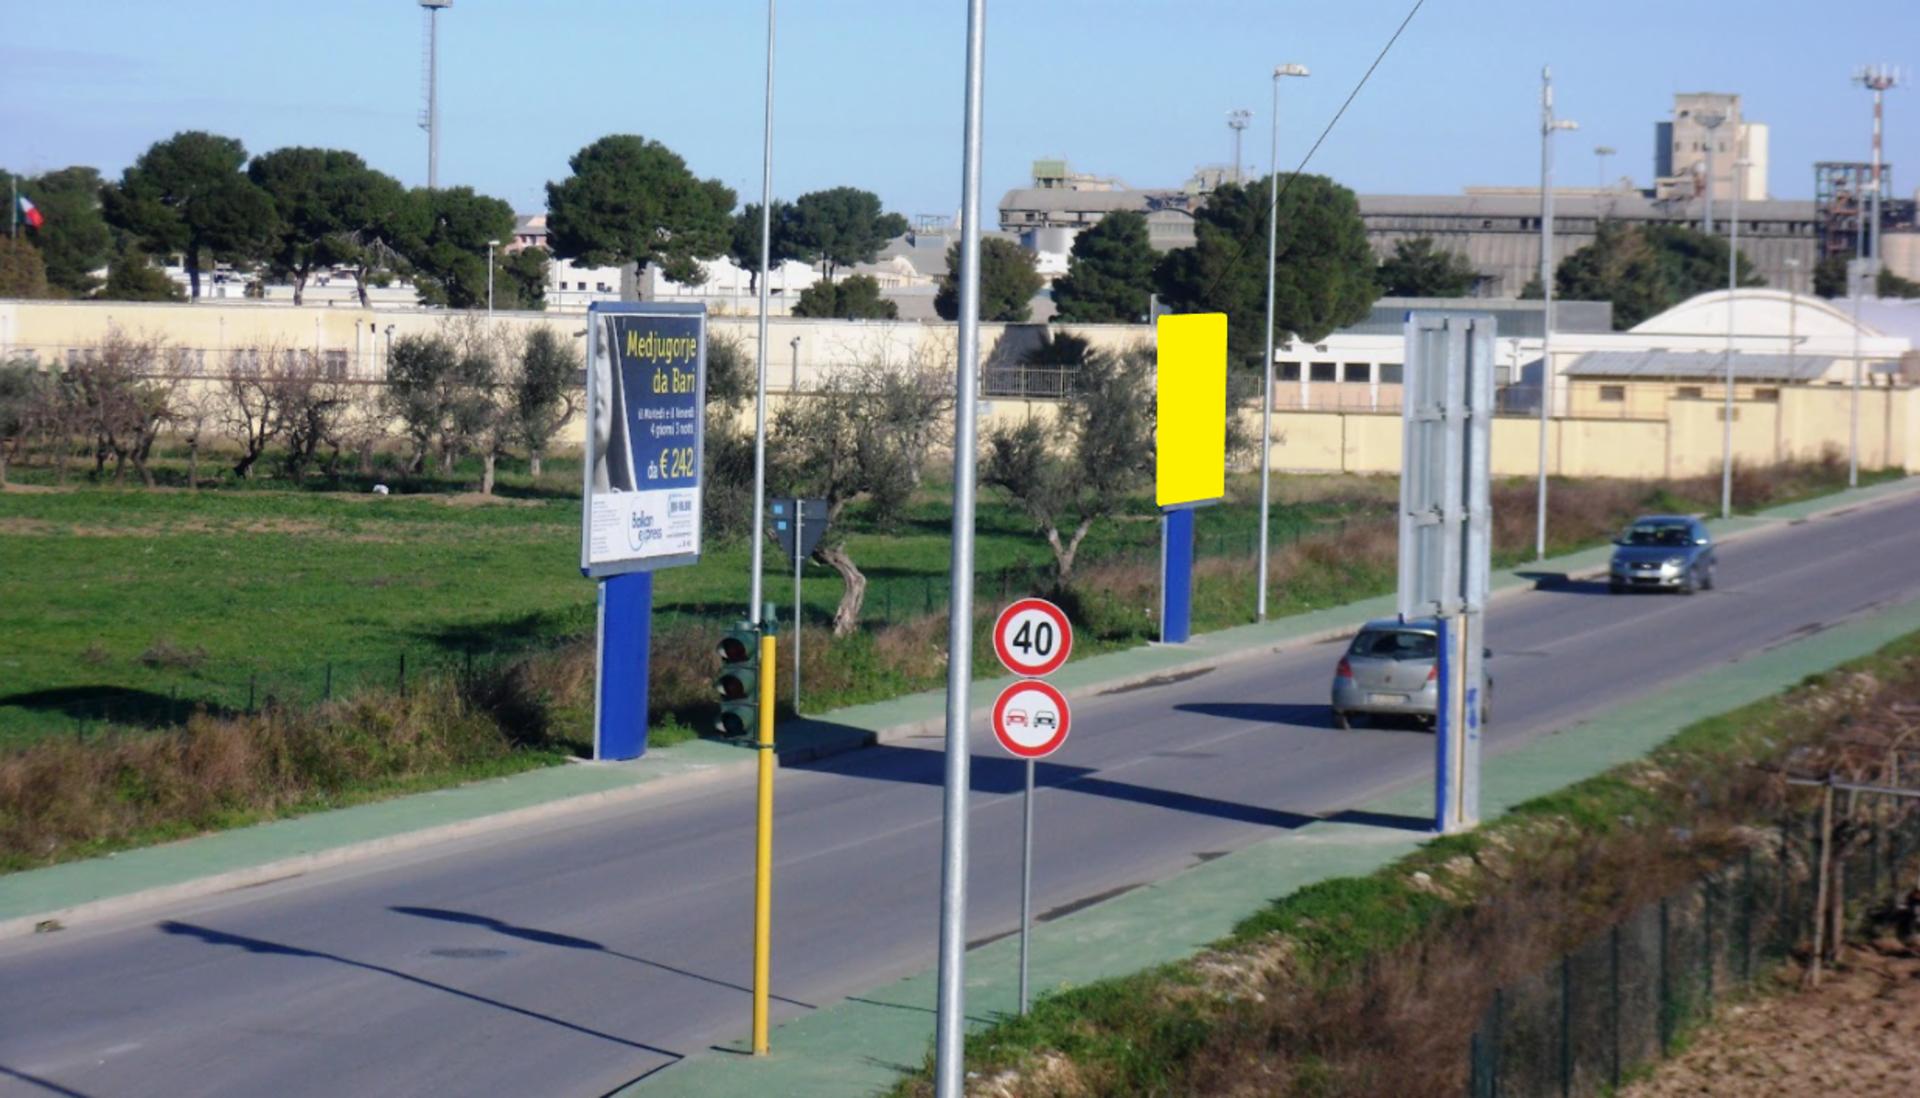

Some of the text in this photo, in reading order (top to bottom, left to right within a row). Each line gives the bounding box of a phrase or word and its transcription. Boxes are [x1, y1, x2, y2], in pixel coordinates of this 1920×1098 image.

[626, 329, 697, 364] Medjugorje
[653, 366, 696, 394] da Bari
[648, 460, 658, 479] da
[671, 447, 694, 478] 242
[1012, 620, 1053, 656] 40
